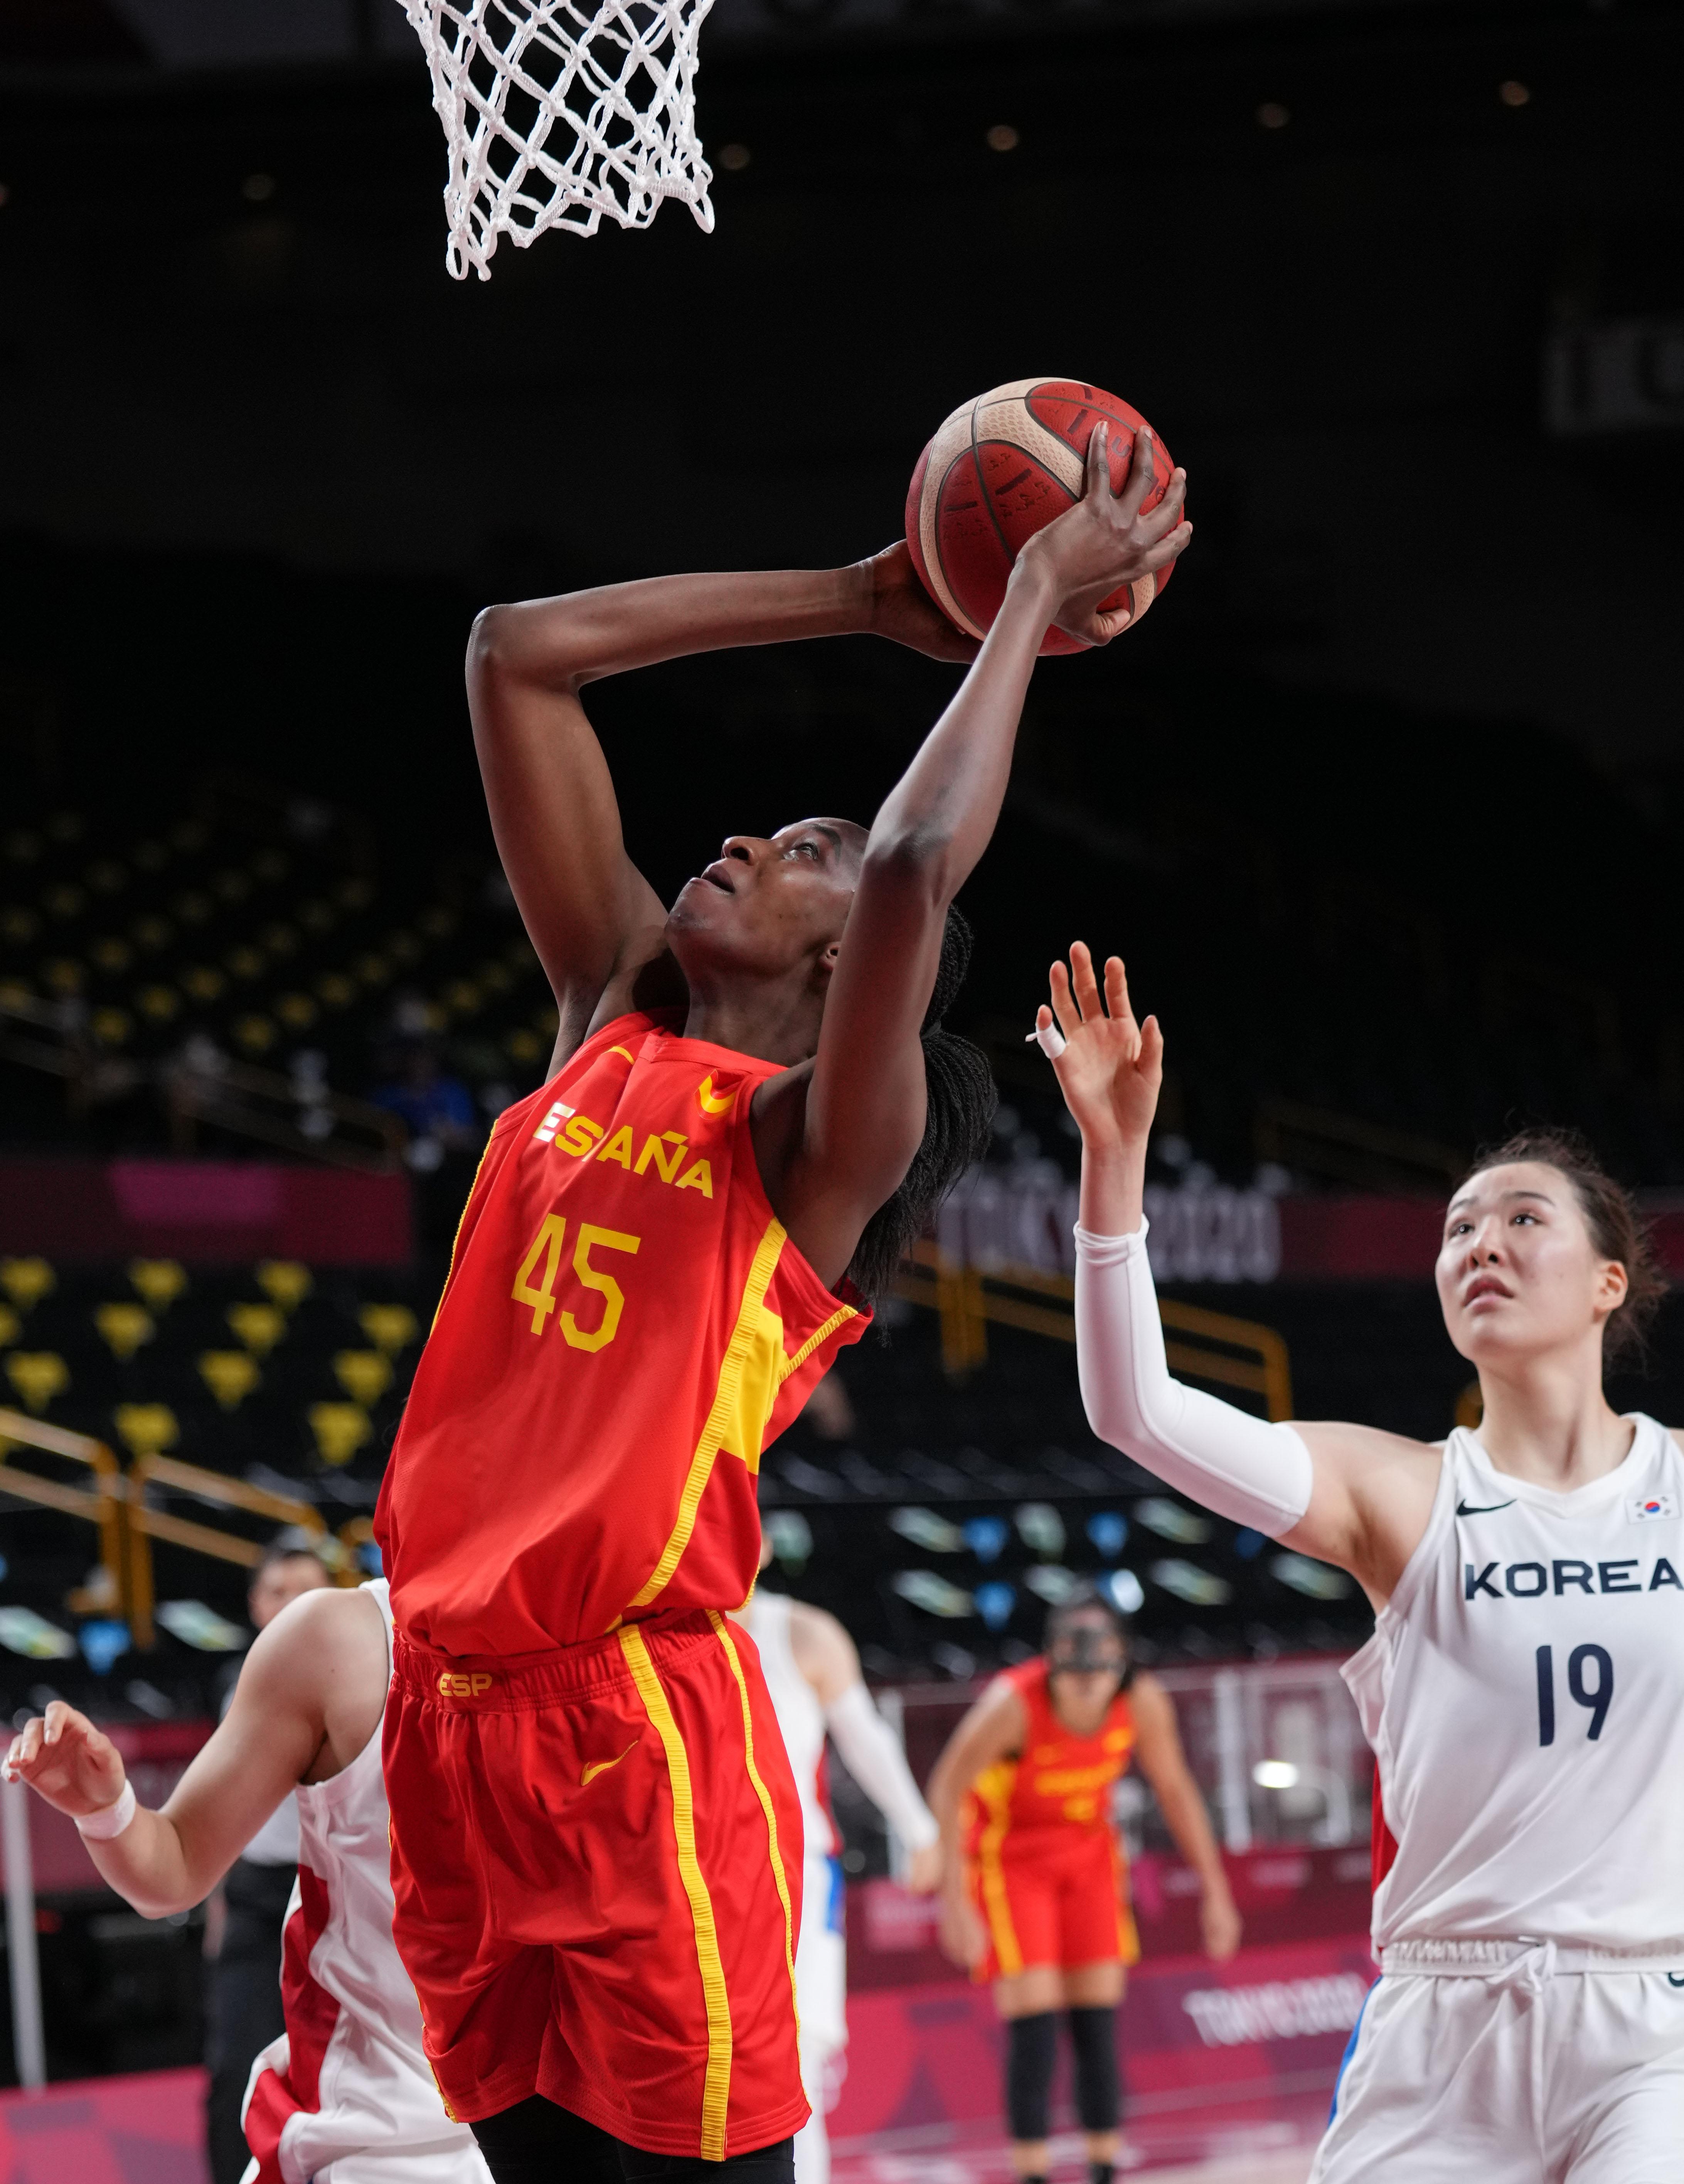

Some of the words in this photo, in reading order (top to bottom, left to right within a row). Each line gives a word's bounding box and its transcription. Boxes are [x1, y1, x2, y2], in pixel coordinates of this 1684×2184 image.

[532, 1102, 713, 1199] ESAÑA
[511, 1212, 641, 1353] 45
[1465, 1558, 1684, 1601] KOREA
[437, 1673, 493, 1697] ESP
[1536, 1643, 1614, 1747] 19
